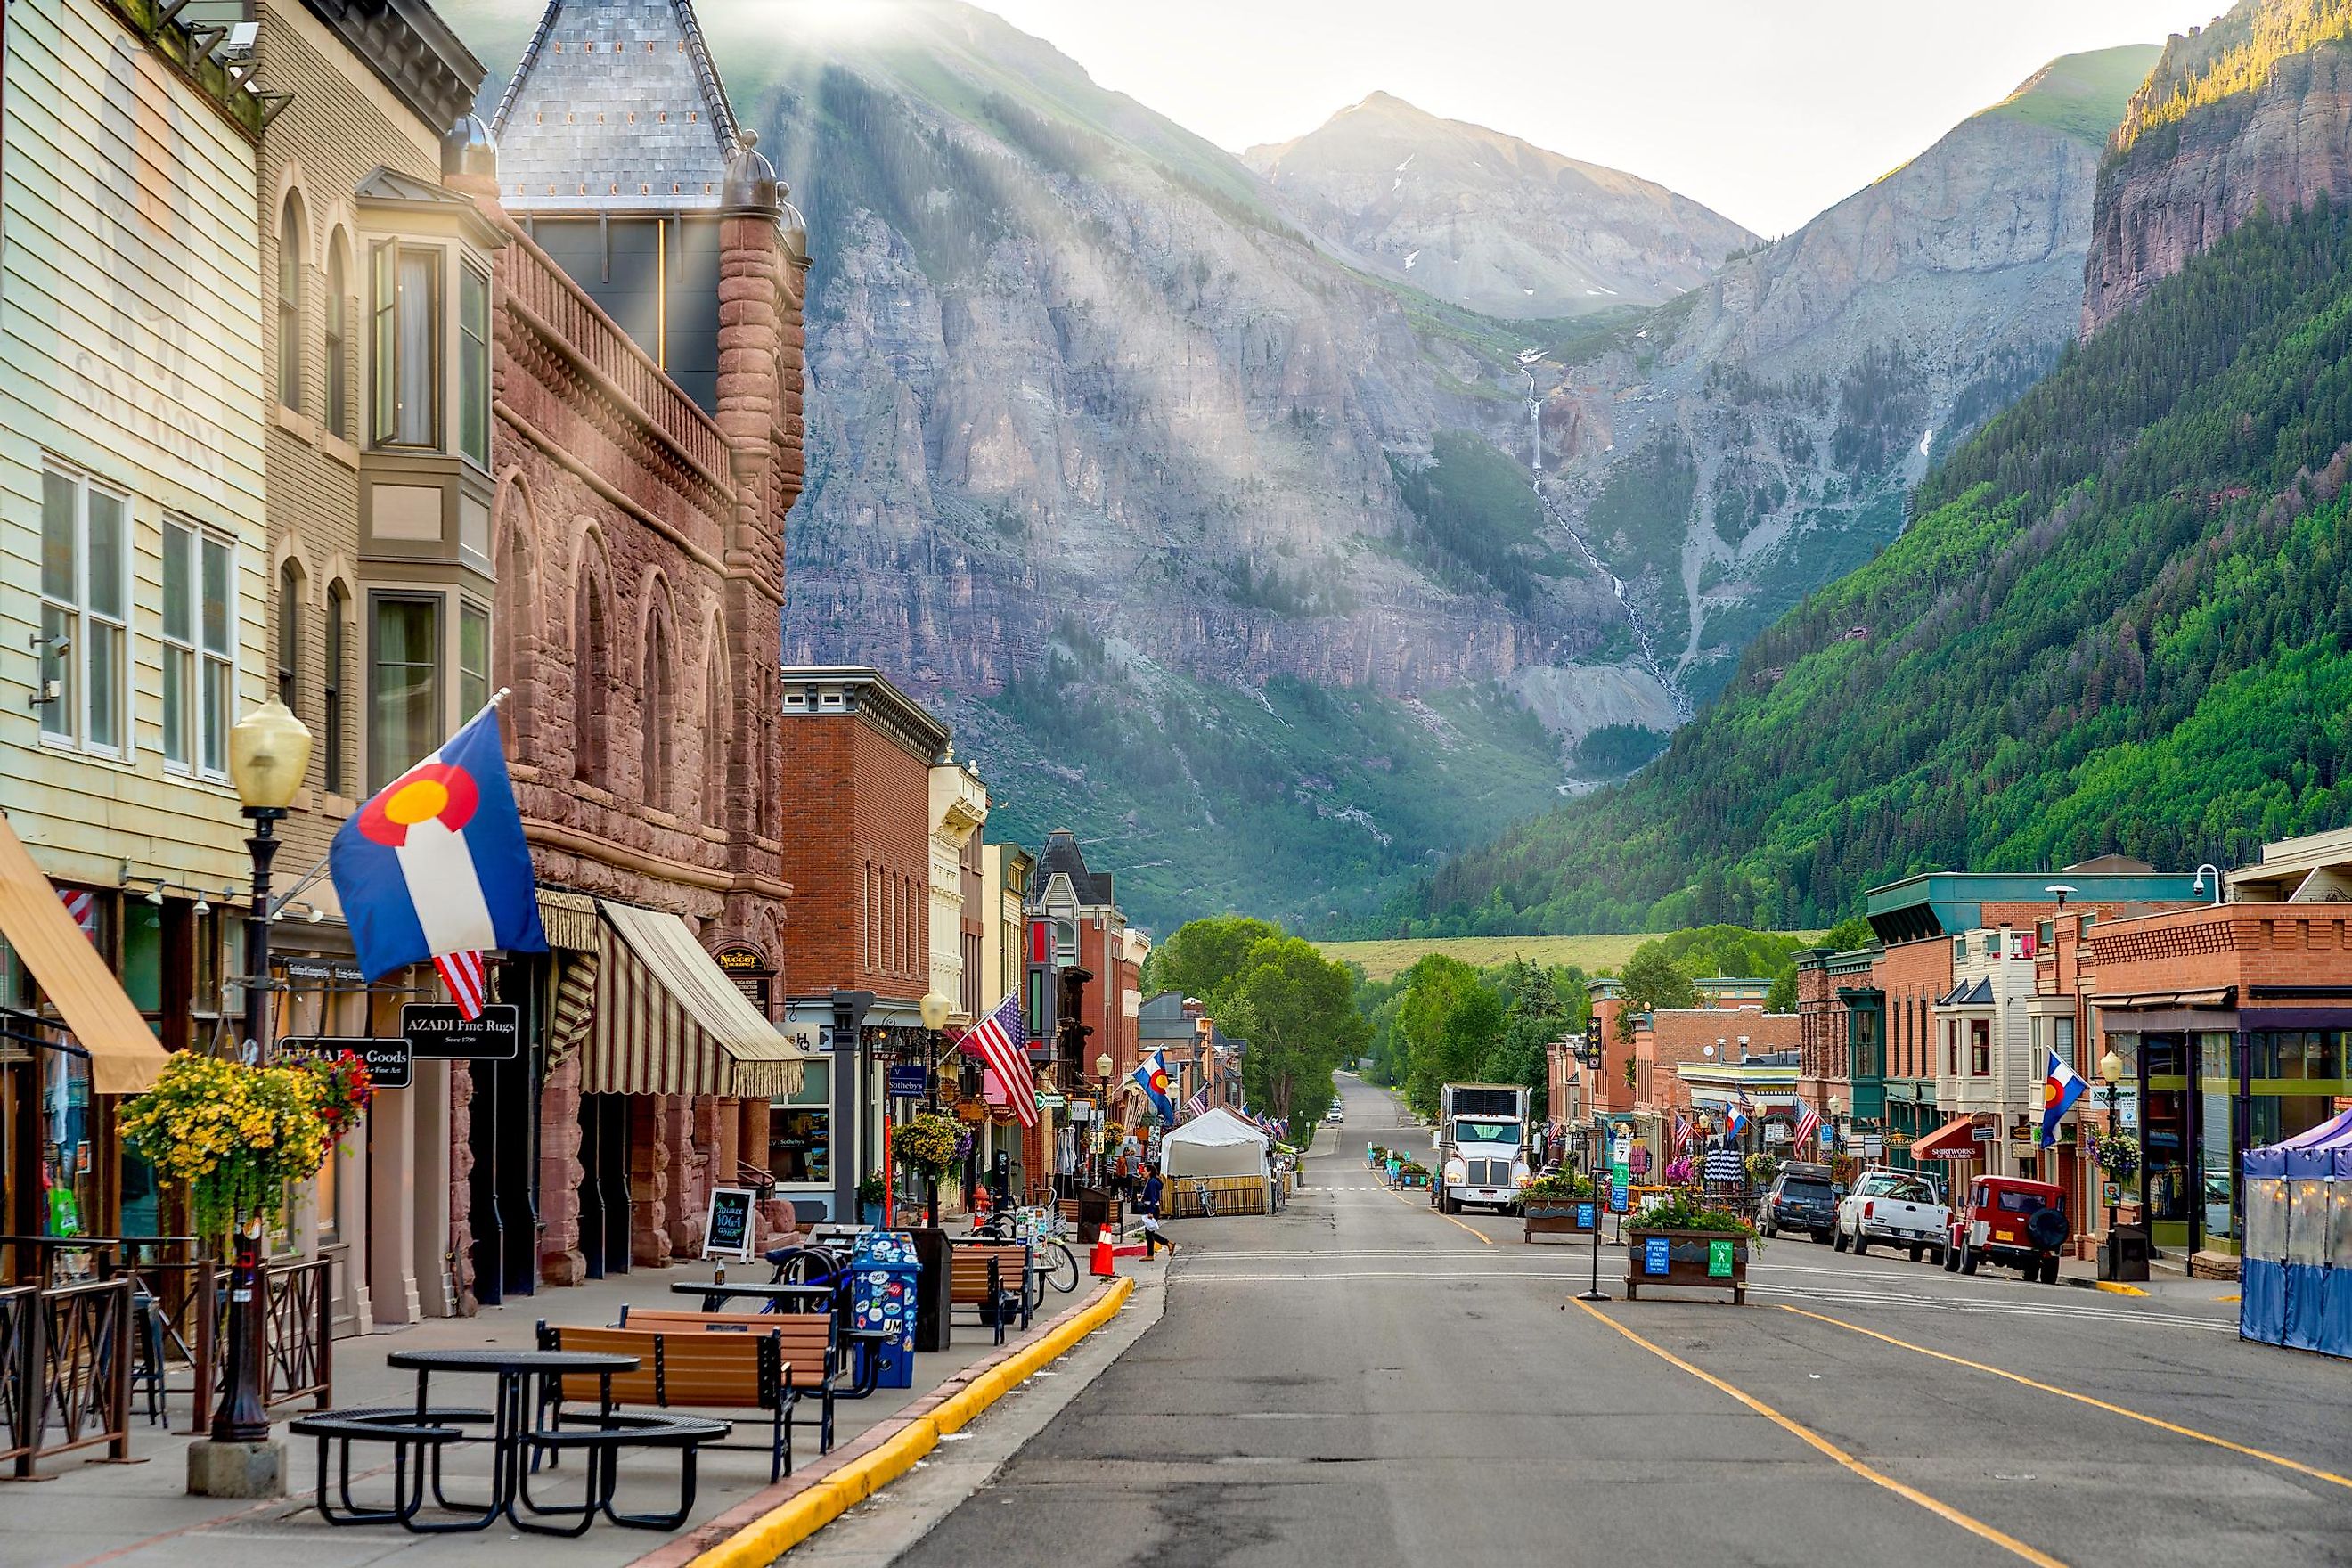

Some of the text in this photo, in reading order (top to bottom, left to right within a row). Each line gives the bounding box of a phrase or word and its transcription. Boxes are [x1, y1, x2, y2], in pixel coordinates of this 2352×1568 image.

[720, 954, 756, 968] NUGGET
[407, 1019, 515, 1034] AZADI Fine Rugs
[365, 1049, 407, 1063] Goods
[889, 1081, 923, 1091] Sotheby's
[1618, 1150, 1625, 1159] 7
[1931, 1147, 1976, 1156] SHIRTWORKS
[884, 1319, 902, 1332] JM
